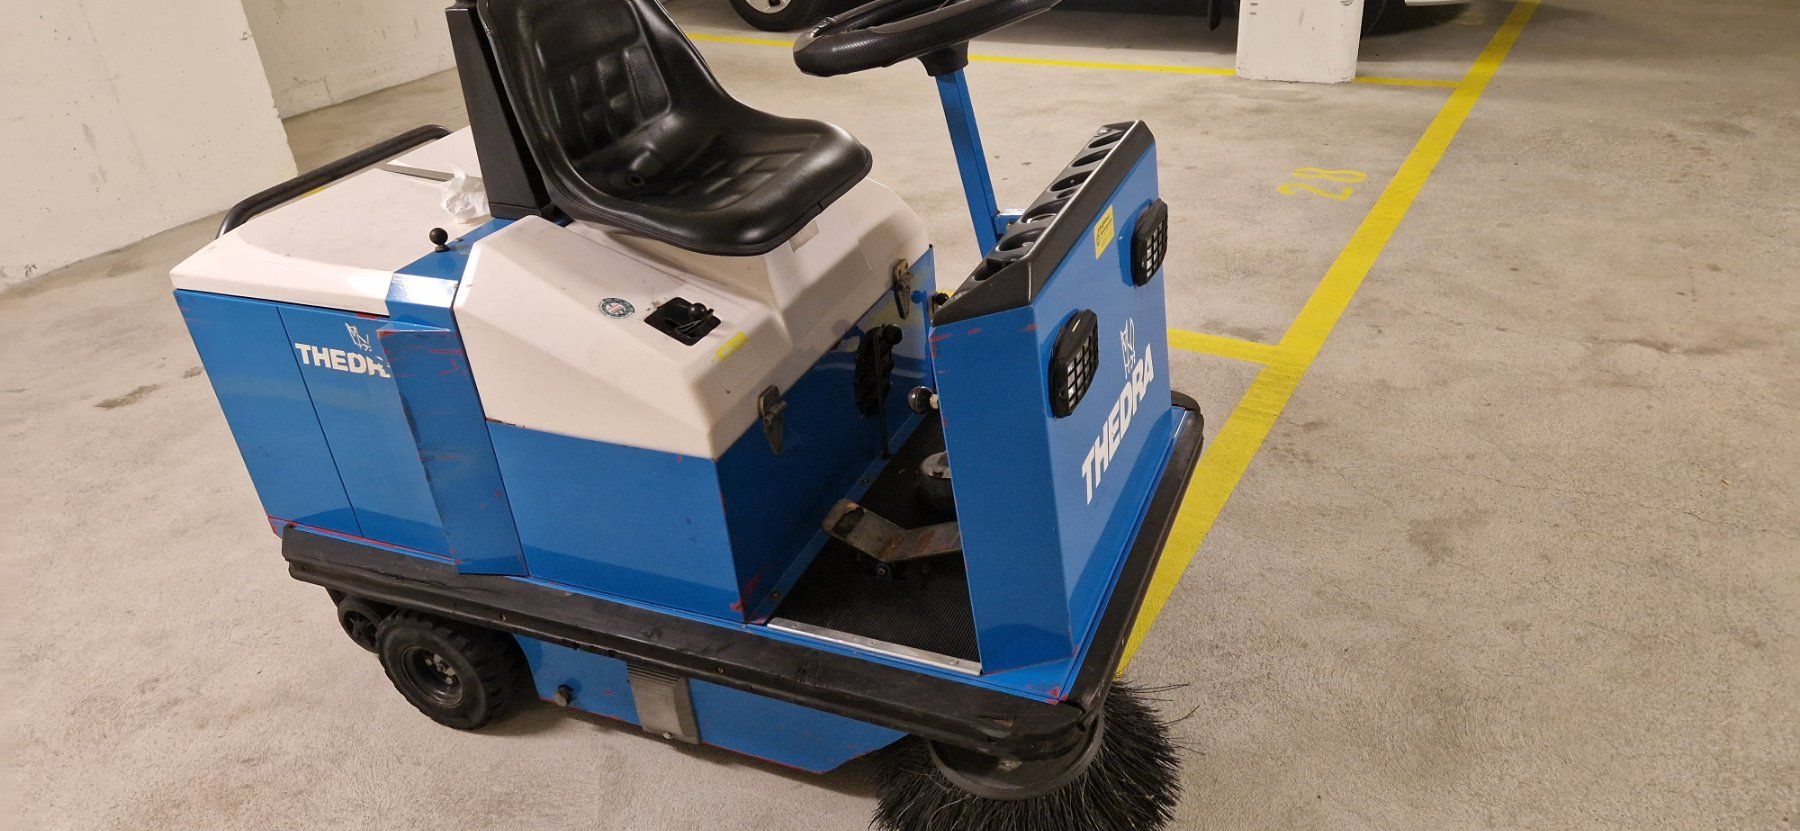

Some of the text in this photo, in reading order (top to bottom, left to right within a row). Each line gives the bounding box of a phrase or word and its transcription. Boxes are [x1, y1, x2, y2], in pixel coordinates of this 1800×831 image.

[1276, 166, 1367, 202] 28
[294, 342, 391, 379] THEDR
[1082, 343, 1155, 506] THEDRA
